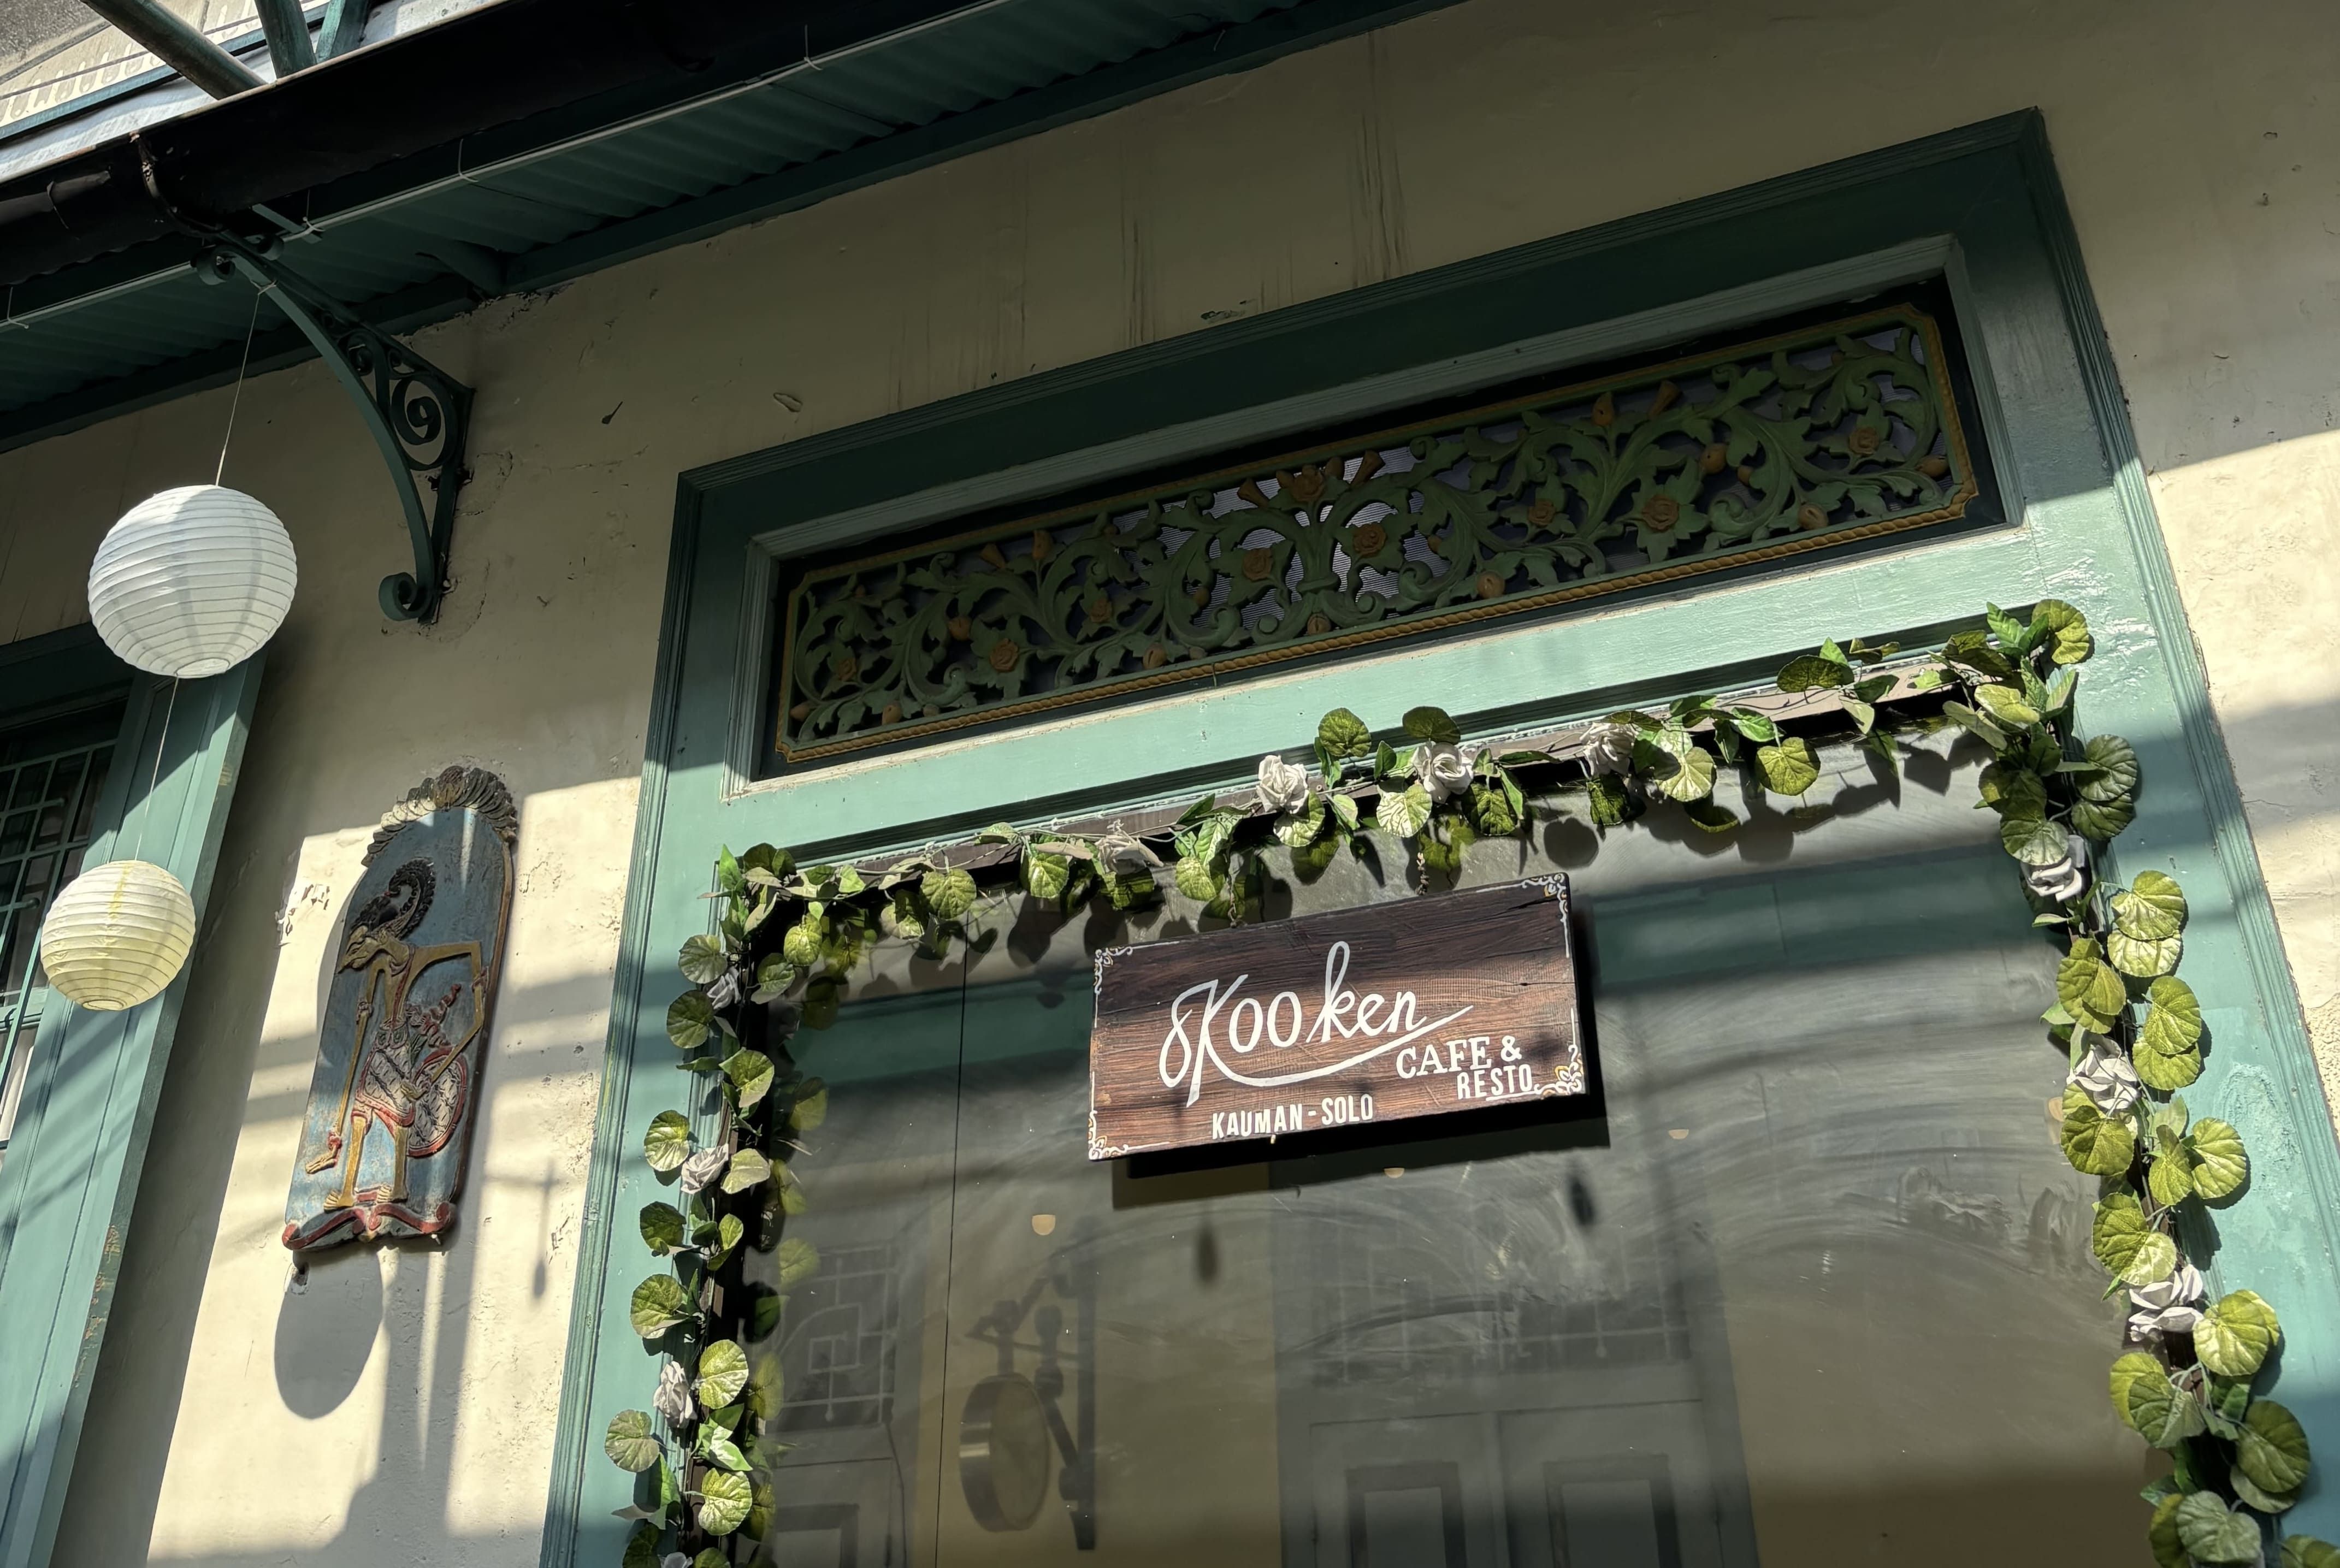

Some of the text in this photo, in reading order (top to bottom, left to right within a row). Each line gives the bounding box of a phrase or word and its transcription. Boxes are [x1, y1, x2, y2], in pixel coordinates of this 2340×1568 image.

[1396, 1035, 1522, 1079] CAFE &
[1456, 1063, 1533, 1100] RESTO
